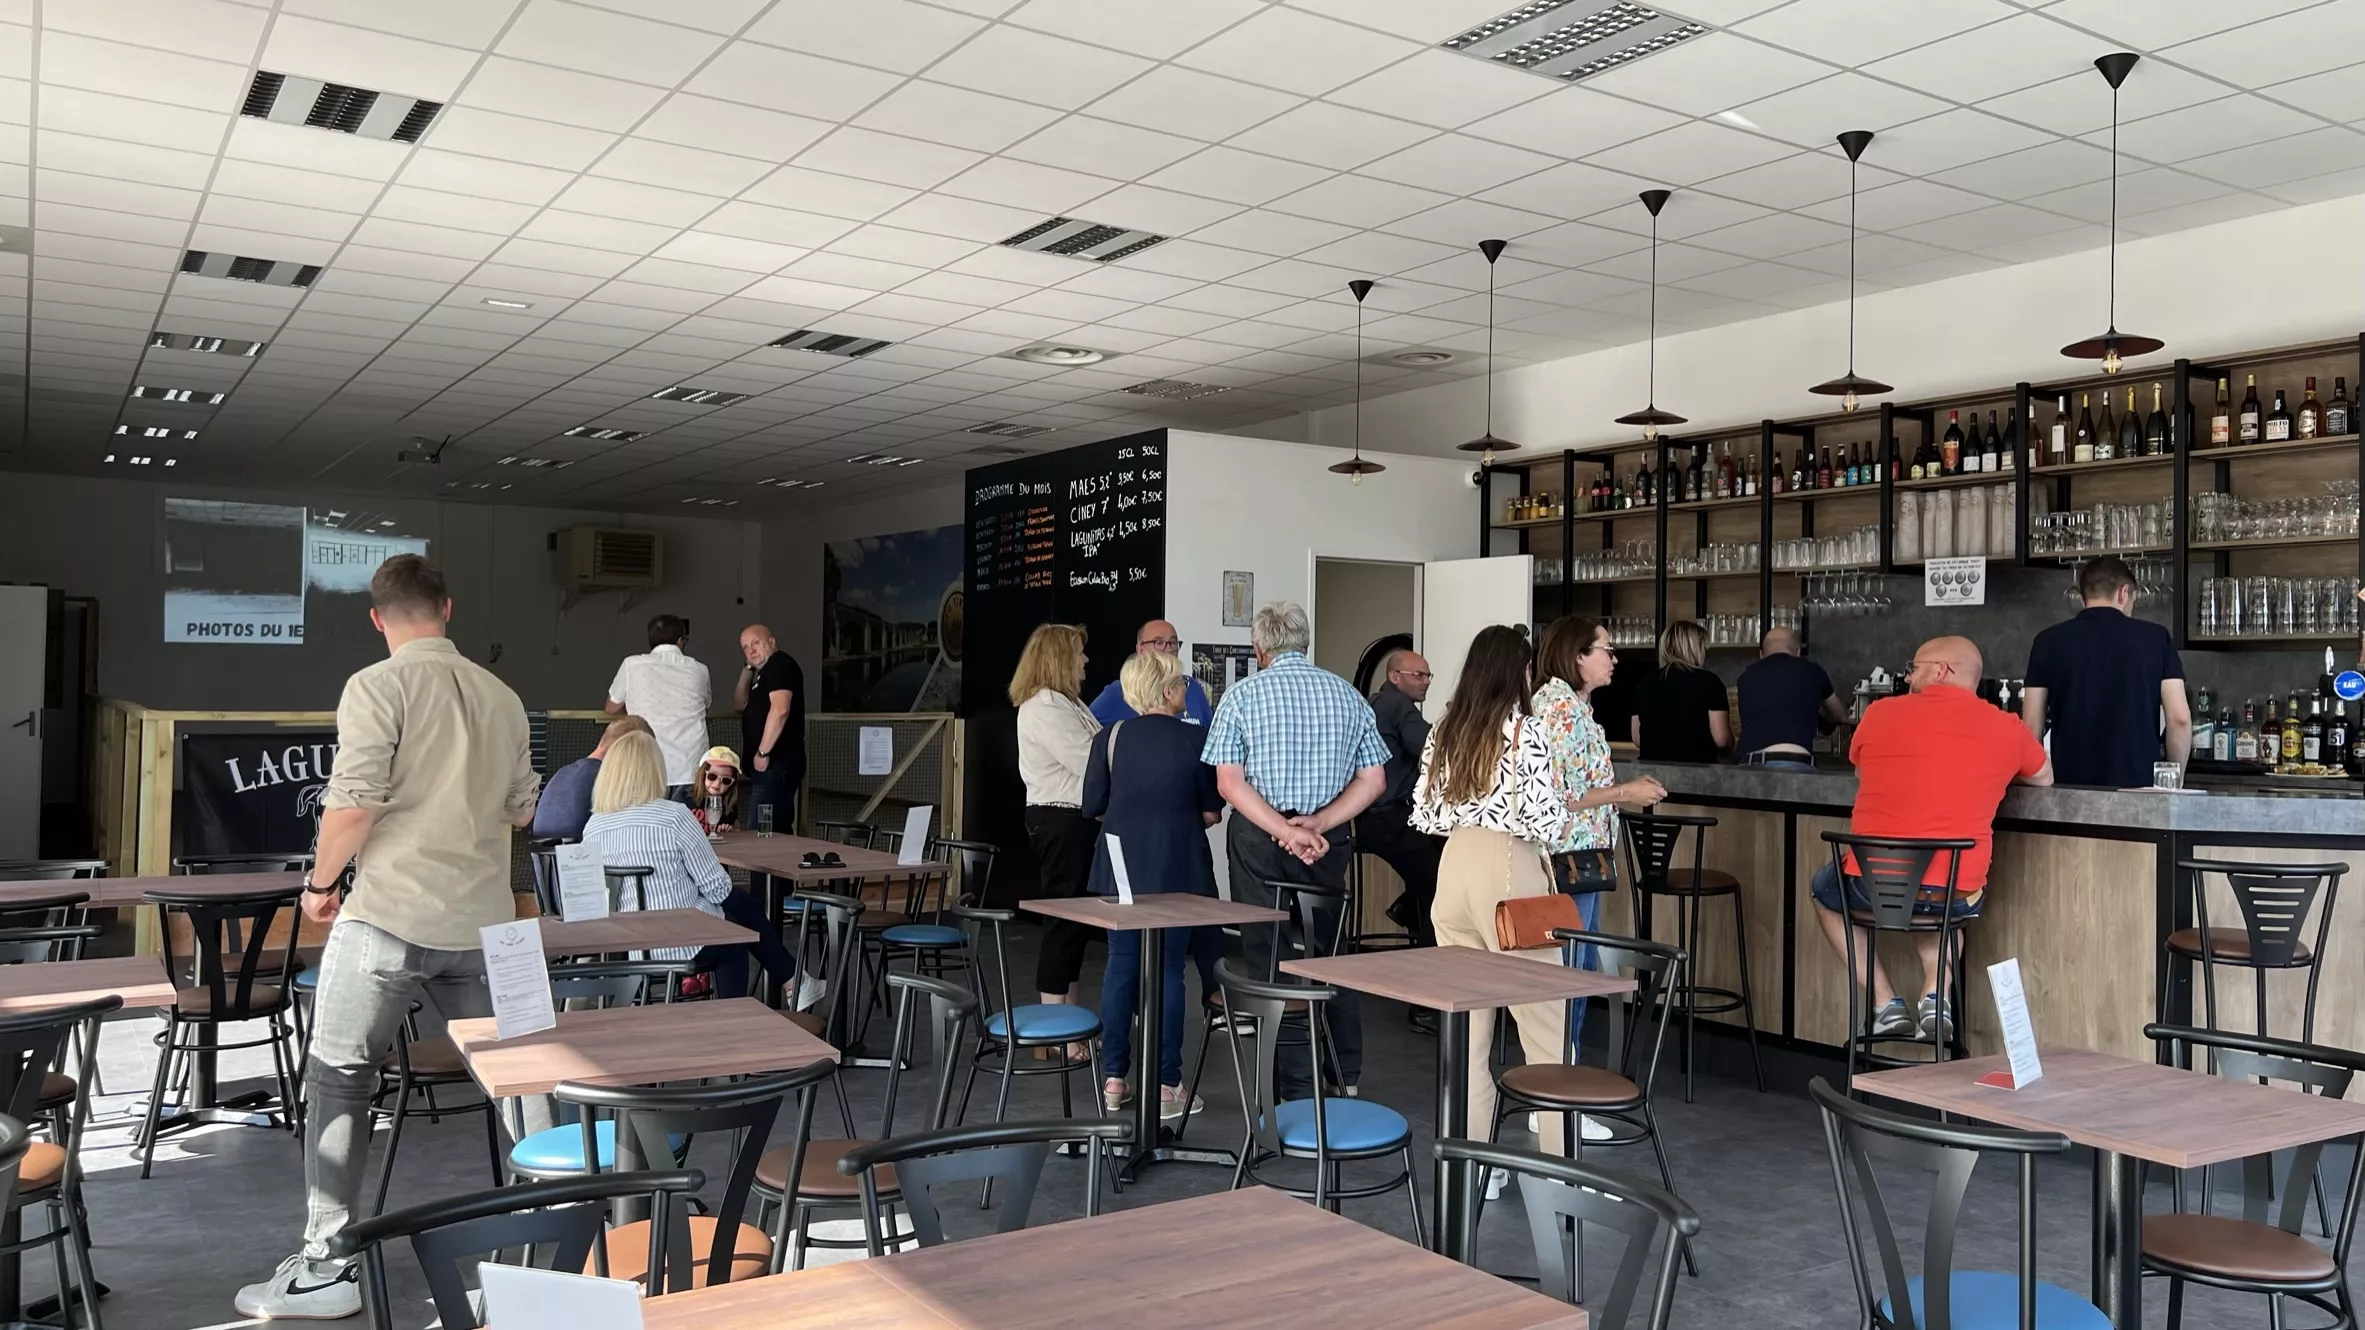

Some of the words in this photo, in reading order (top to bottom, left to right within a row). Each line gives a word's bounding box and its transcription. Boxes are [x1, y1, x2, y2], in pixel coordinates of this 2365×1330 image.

[1142, 445, 1159, 456] 50CL
[1018, 483, 1030, 496] DU
[1069, 477, 1096, 500] MAES
[1142, 468, 1162, 482] 6,50€
[1118, 493, 1138, 512] 4,00€
[1141, 490, 1163, 504] 7,50€
[1119, 521, 1138, 539] 4,50€
[1141, 517, 1162, 531] 8,50€
[1129, 567, 1148, 582] 5,50€
[187, 622, 255, 637] PHOTOS
[261, 623, 283, 638] DU
[2330, 732, 2342, 745] 51
